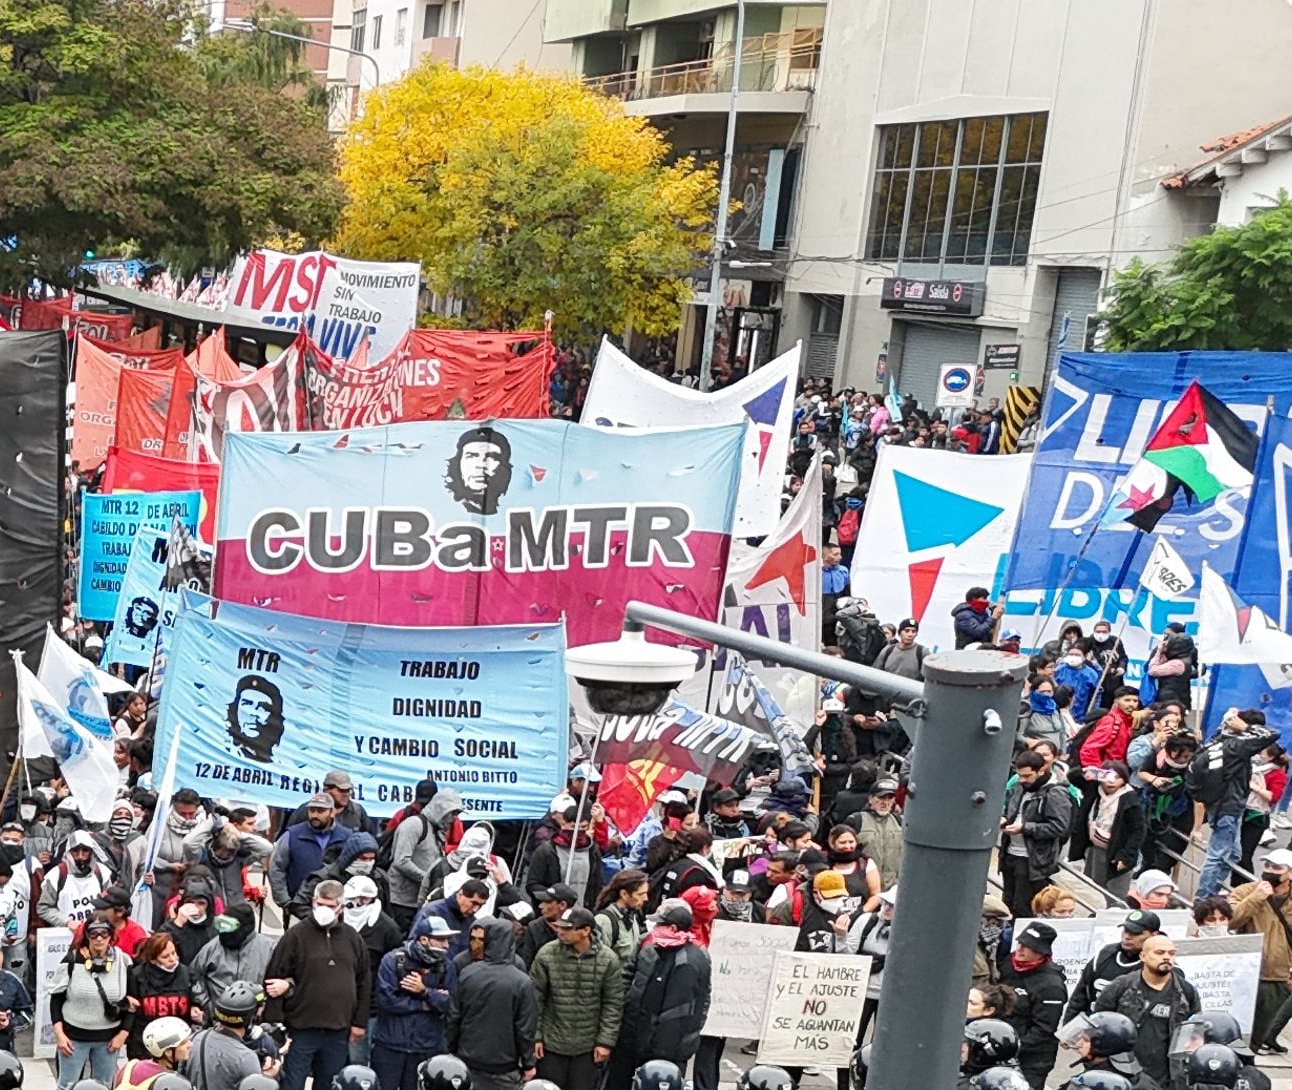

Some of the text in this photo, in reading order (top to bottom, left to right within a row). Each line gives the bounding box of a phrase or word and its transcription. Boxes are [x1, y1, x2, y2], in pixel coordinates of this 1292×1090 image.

[234, 251, 336, 312] MST
[340, 271, 415, 289] MOVIMIENTO
[333, 286, 355, 301] SIN
[328, 303, 382, 324] TRABAJO
[101, 500, 121, 515] MTR
[125, 501, 139, 515] 12
[148, 505, 160, 519] DE
[247, 506, 491, 574] CUBa
[505, 503, 697, 573] MTR
[101, 542, 131, 556] TRABAJ
[238, 647, 281, 673] MTR
[400, 660, 480, 680] TRABAJO
[392, 697, 482, 719] DIGNIDAD
[354, 735, 518, 760] Y CAMBIO SOCIAL
[195, 762, 211, 779] 12
[213, 765, 230, 781] DE
[233, 767, 273, 786] ABRIL
[427, 768, 517, 784] ANTONIO BITTO
[792, 965, 862, 980] EL HAMBRE
[789, 983, 803, 996] EL
[810, 983, 858, 998] AJUSTE
[803, 1000, 827, 1016] NO
[773, 1018, 855, 1034] SE AGUANTAN
[795, 1034, 829, 1050] MÁS
[1237, 1079, 1252, 1090] FA
